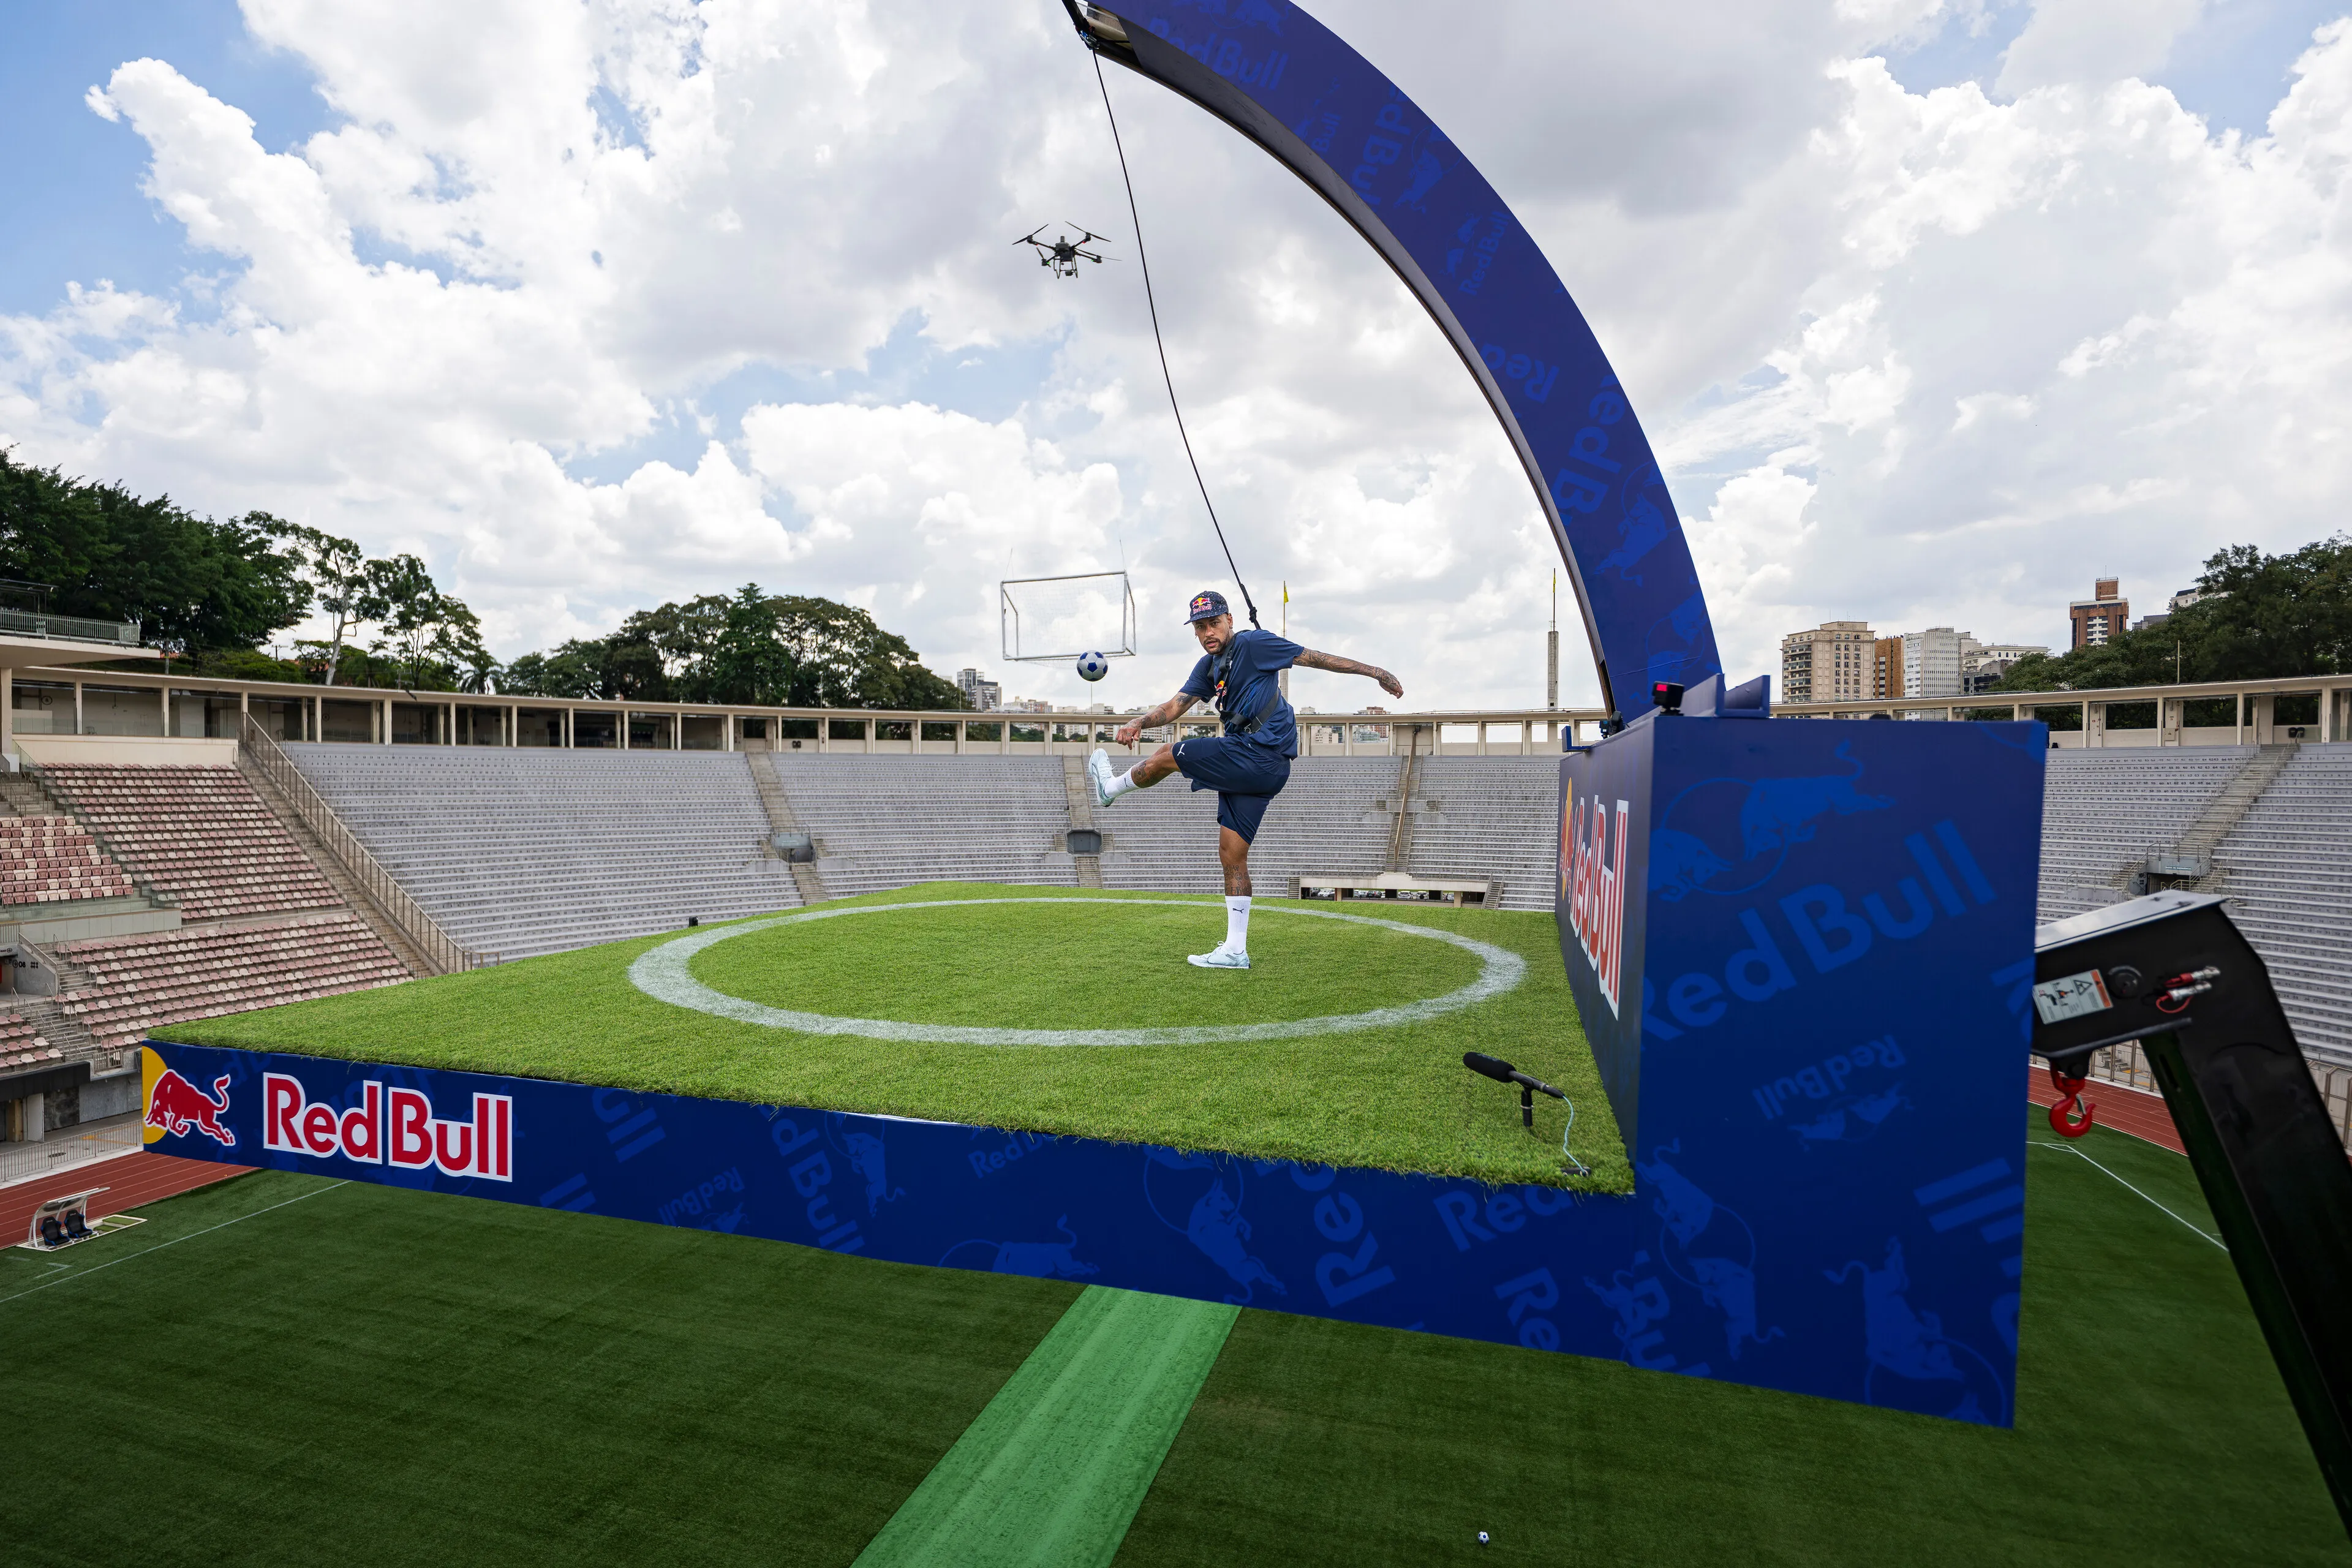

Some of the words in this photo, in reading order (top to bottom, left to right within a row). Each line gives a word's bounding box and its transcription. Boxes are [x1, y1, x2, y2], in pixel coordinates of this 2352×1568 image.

[1212, 38, 1289, 90] Bull
[1459, 251, 1493, 296] Red
[1478, 211, 1512, 252] Bull
[1570, 794, 1599, 956] Red
[1587, 799, 1629, 1022] Bull
[1778, 820, 1997, 974] Bull
[1823, 1035, 1906, 1092] Red
[1752, 1065, 1831, 1121] Bull
[263, 1072, 382, 1164] Red
[388, 1087, 513, 1182] Bull
[968, 1135, 1023, 1179] Red
[698, 1166, 745, 1209] Red
